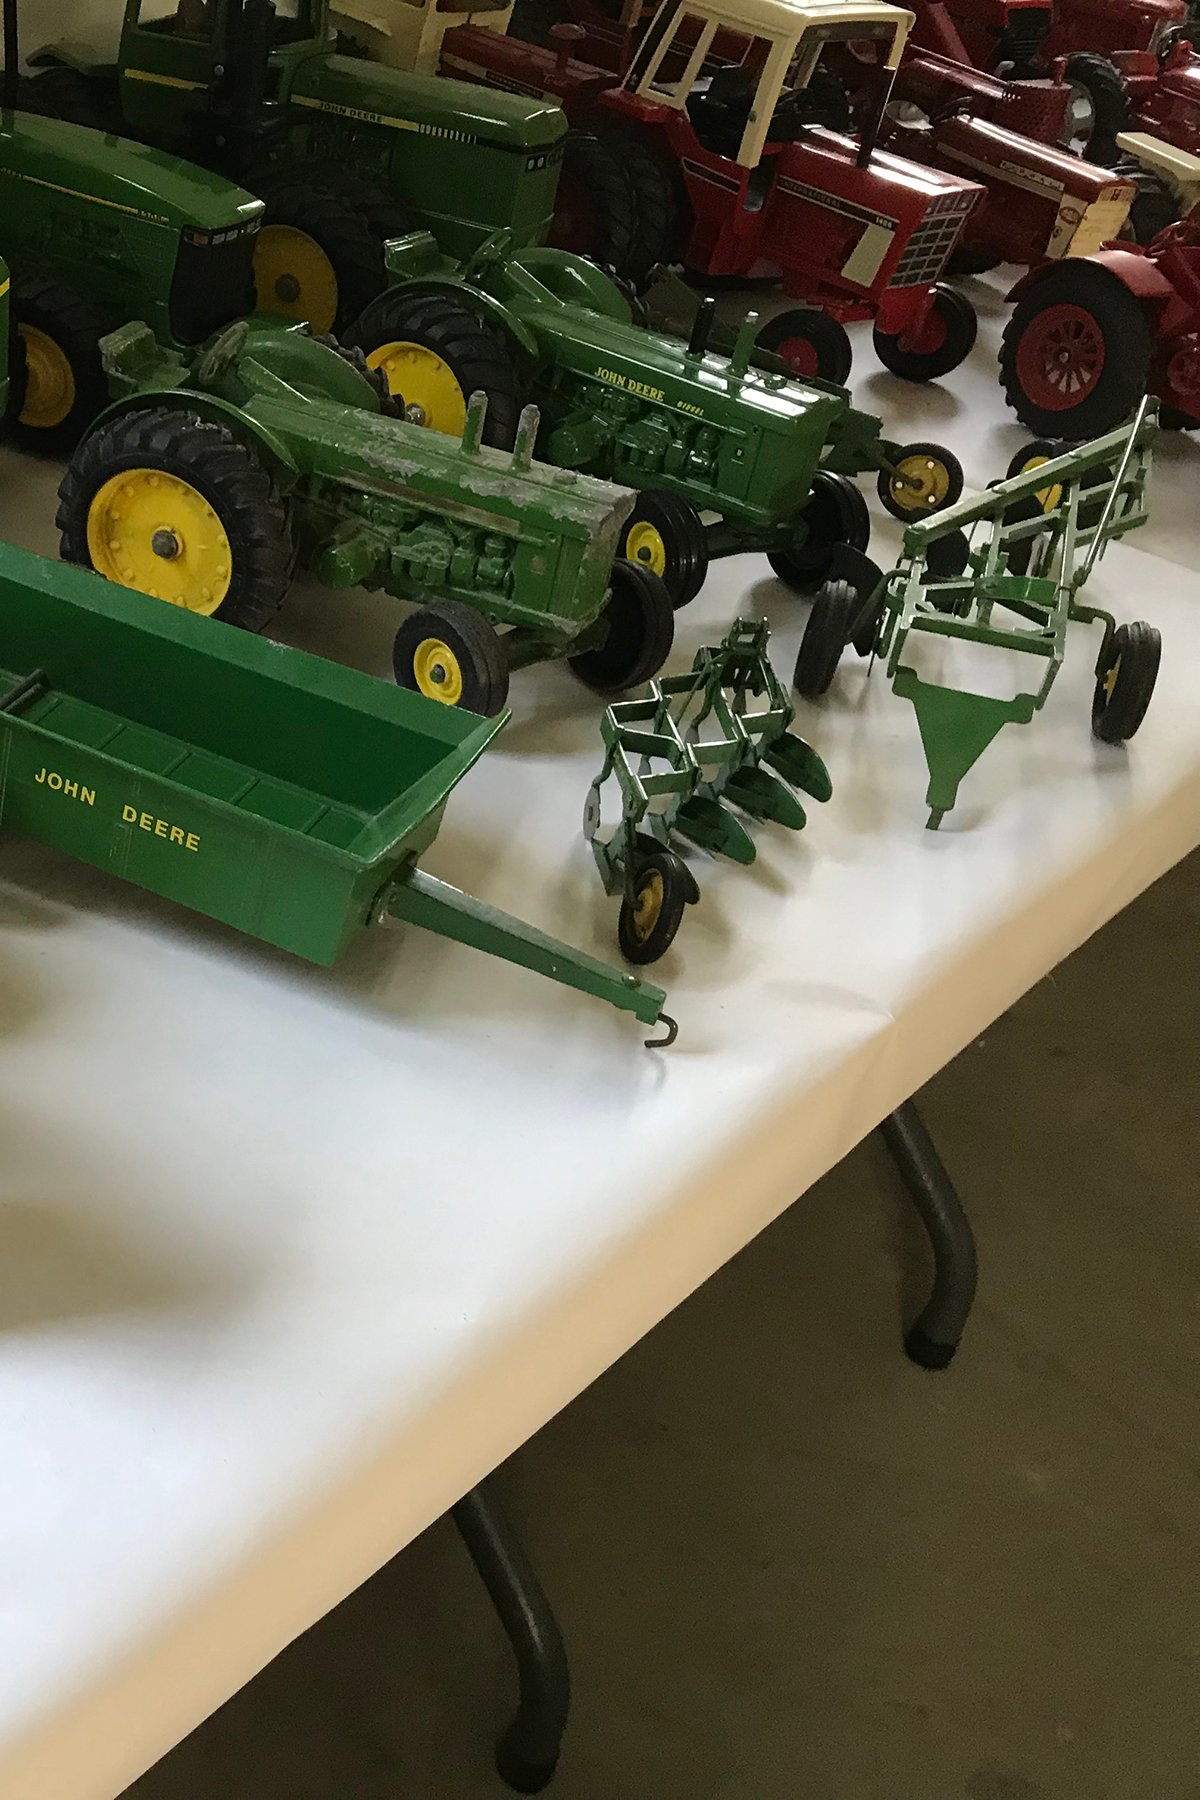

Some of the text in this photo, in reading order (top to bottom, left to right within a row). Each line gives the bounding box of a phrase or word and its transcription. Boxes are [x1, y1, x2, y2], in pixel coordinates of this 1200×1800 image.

[594, 367, 705, 416] JOHN DEERE DIESEL
[34, 767, 201, 852] JOHN DEERE
